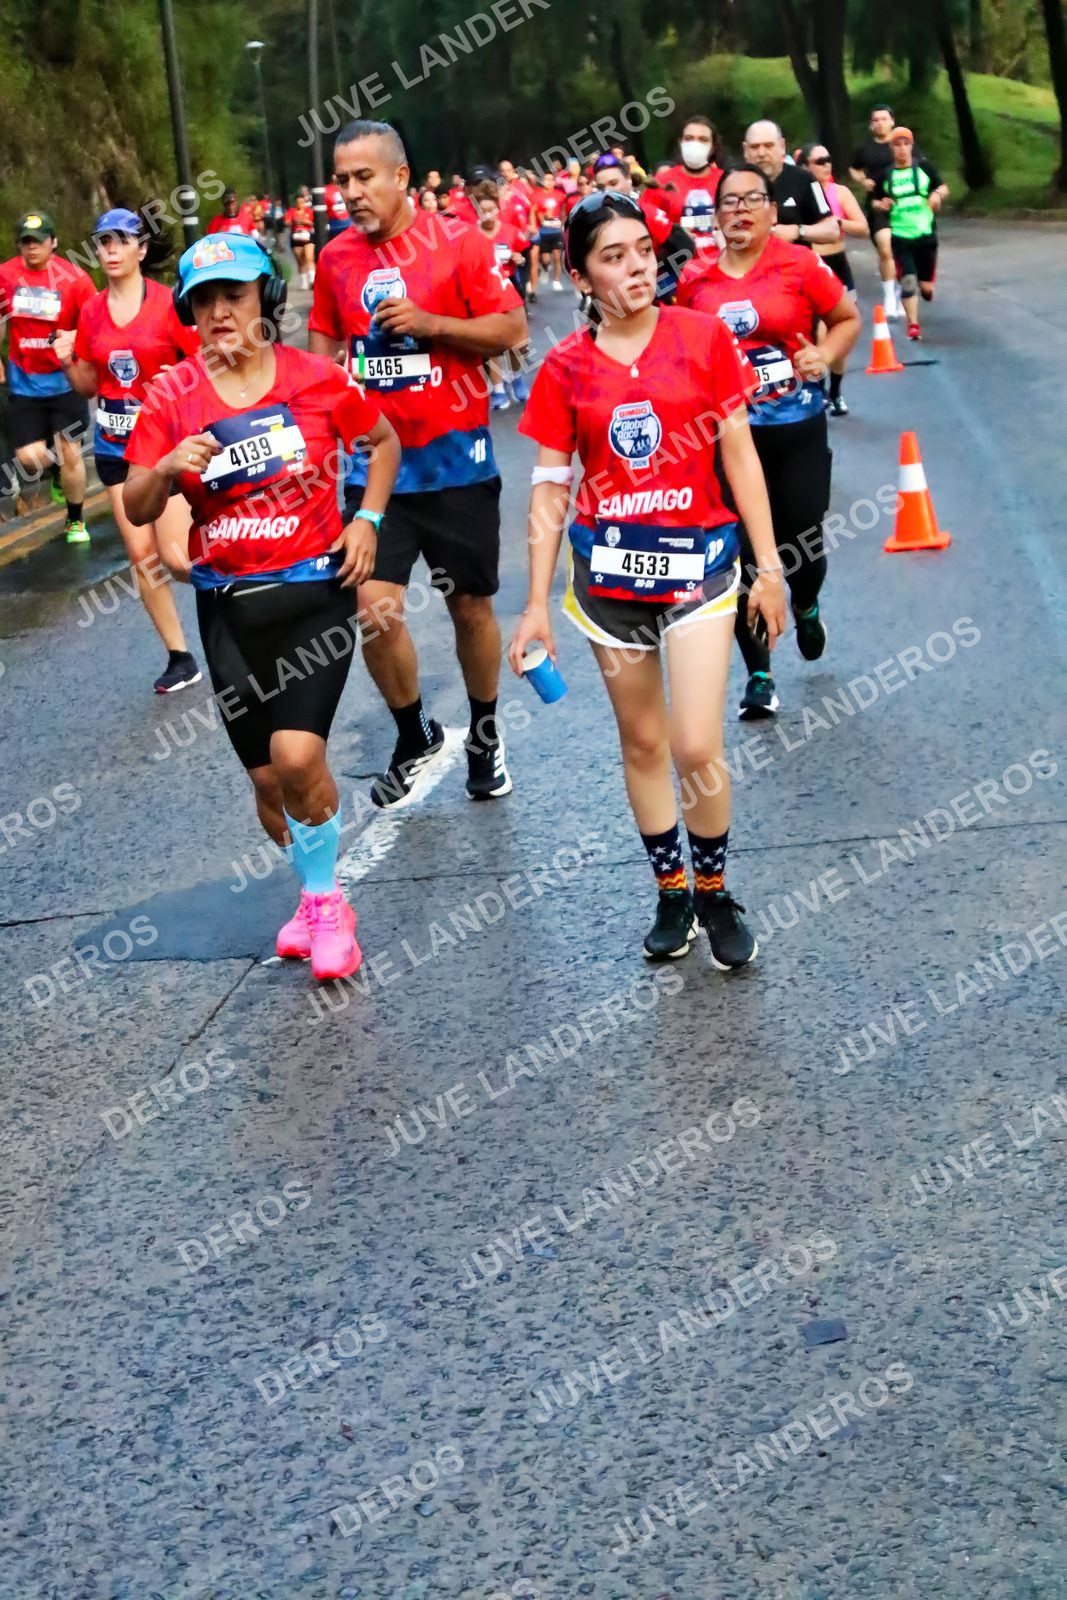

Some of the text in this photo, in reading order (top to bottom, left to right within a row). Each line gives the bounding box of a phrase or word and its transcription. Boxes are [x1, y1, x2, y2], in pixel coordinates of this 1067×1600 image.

[368, 358, 403, 377] 5465
[108, 414, 132, 428] 5122
[230, 437, 273, 466] 4139
[598, 486, 693, 517] SANTIAGO
[208, 515, 299, 540] SANTIAGO
[621, 552, 670, 577] 4533
